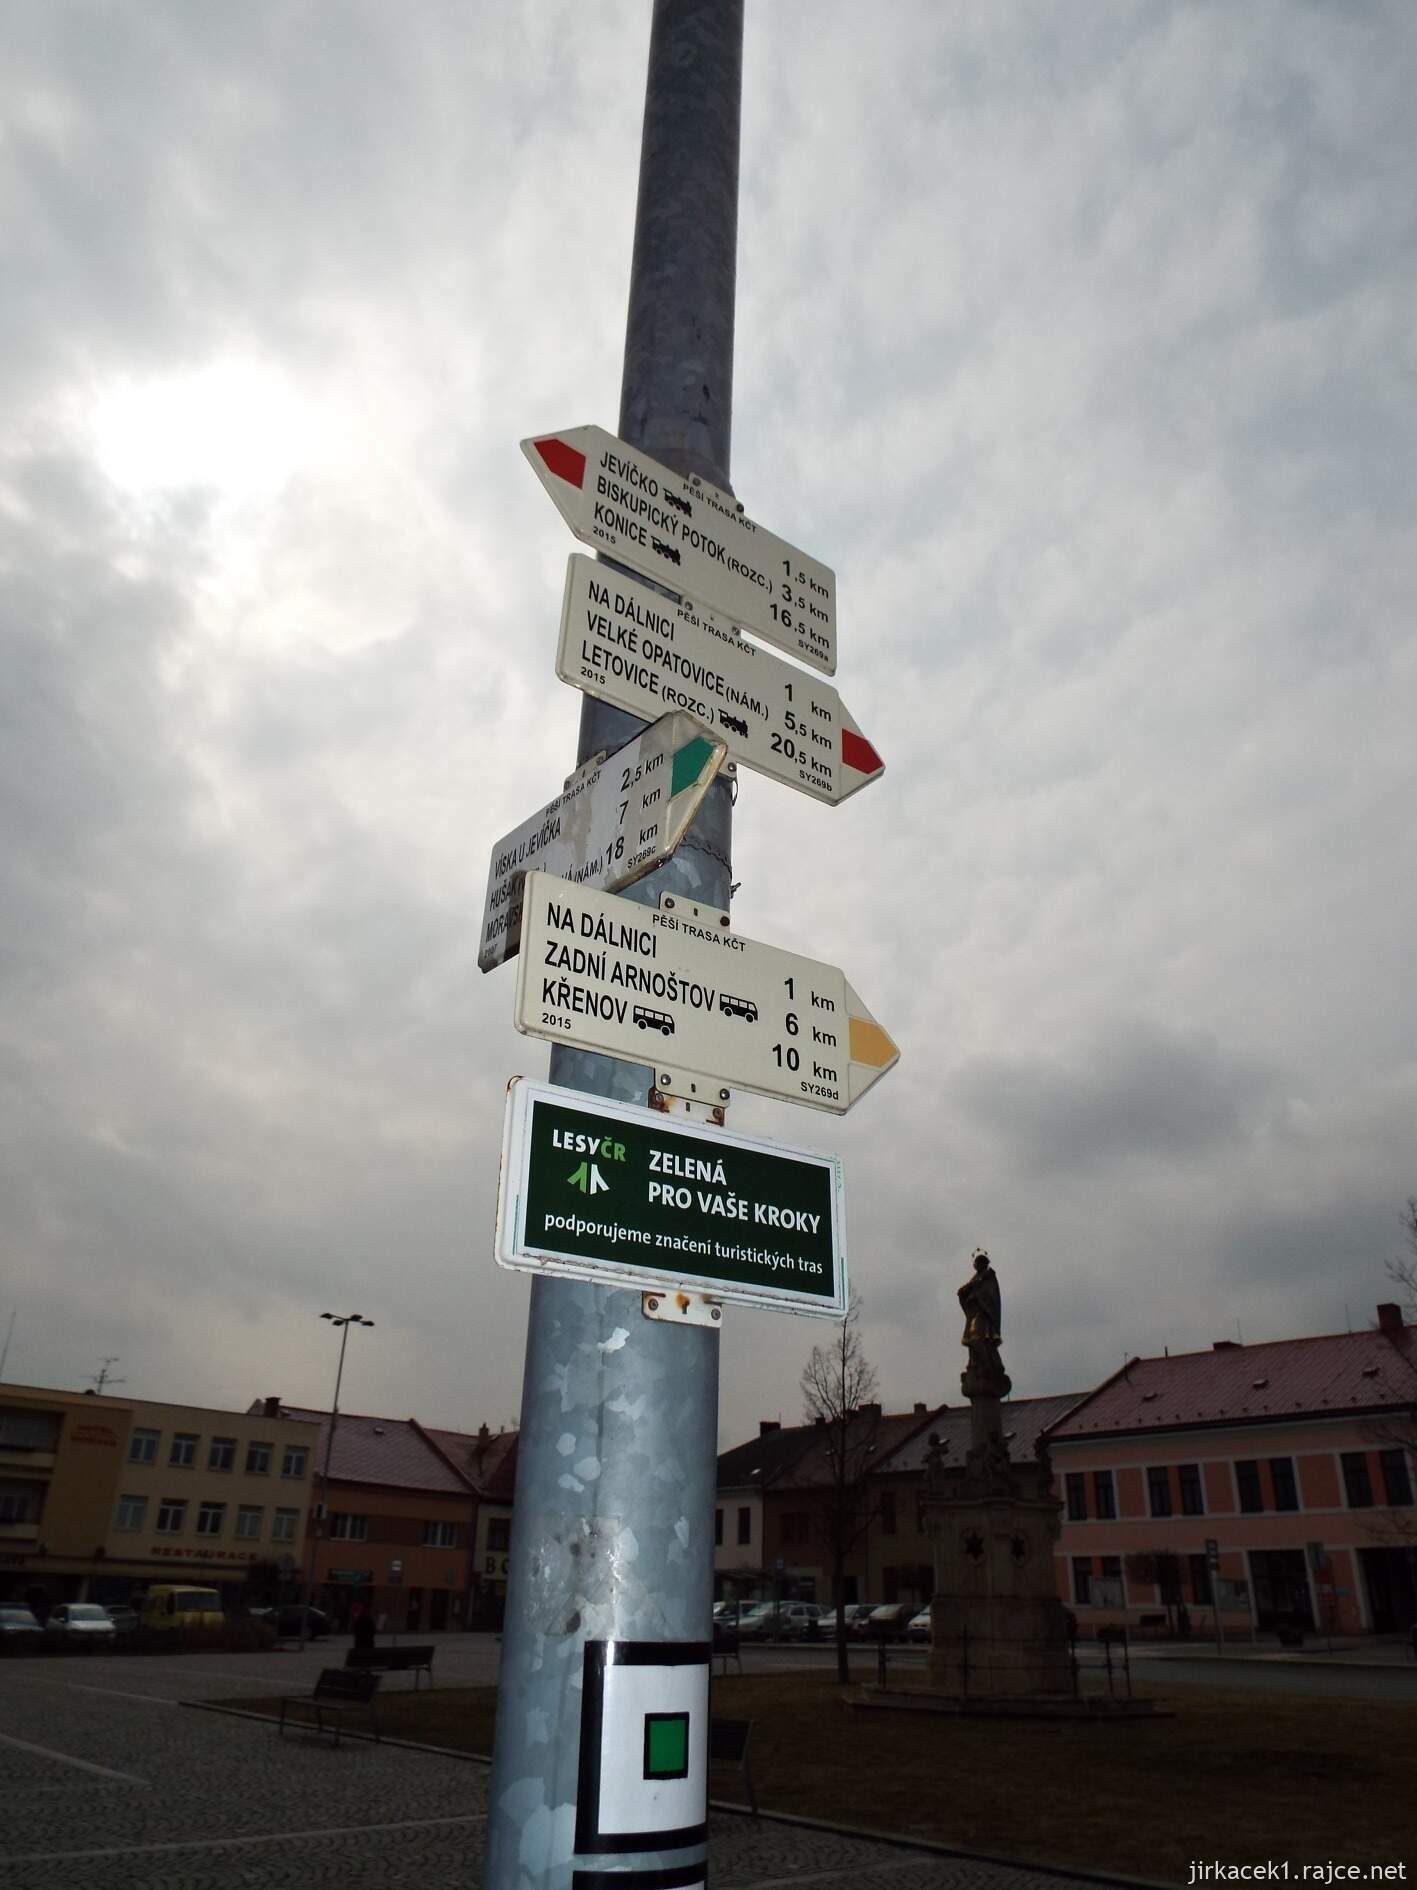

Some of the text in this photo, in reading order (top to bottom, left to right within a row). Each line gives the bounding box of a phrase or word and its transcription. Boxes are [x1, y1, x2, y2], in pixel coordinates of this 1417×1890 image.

[600, 452, 658, 497] JEVÍČKO
[594, 504, 647, 546] KONICE
[683, 484, 756, 532] PĚŠÍ TRASA KČT
[593, 527, 616, 544] 2015
[598, 477, 829, 623] BISKUPICKÝ POTOK (ROZC.) 3,5 km
[783, 561, 829, 598] 1,5 km
[589, 581, 675, 640] NA DÁLNICI
[769, 604, 830, 648] 16,5 km
[677, 610, 756, 656] PĚŠÍ TRASA KČT
[798, 640, 829, 662] SY269a
[580, 667, 605, 685] 2015
[582, 641, 714, 724] LETOVICE (ROZC.)
[587, 611, 832, 750] VELKÉ OPATOVICE (NÁM.) 5,5 km
[785, 684, 832, 722] 1 km
[620, 753, 664, 792] 2,5 km
[771, 733, 832, 777] 20,5 km
[561, 784, 585, 804] TRASA
[586, 771, 601, 787] KČT
[799, 770, 832, 792] SY269b
[619, 788, 661, 824] 7 km
[495, 818, 561, 879] VÍSKA U JEVÍČKA
[606, 837, 625, 863] 18
[639, 823, 658, 845] km
[627, 845, 656, 868] SY269c
[548, 903, 657, 958] NA DÁLNICI
[653, 914, 745, 952] PĚŠÍ TRASA KČT
[545, 941, 715, 1011] ZADNÍ ARNOŠTOV
[784, 978, 835, 1011] 1 km
[543, 977, 627, 1023] KŘENOV
[542, 1013, 571, 1029] 2015
[785, 1013, 837, 1047] 6 km
[772, 1044, 837, 1082] 10 km
[801, 1082, 839, 1100] SY269d
[649, 1150, 727, 1185] ZELENÁ
[648, 1182, 820, 1234] PRO VAŠE KROKY
[544, 1213, 823, 1274] podporujeme značení turistických tras
